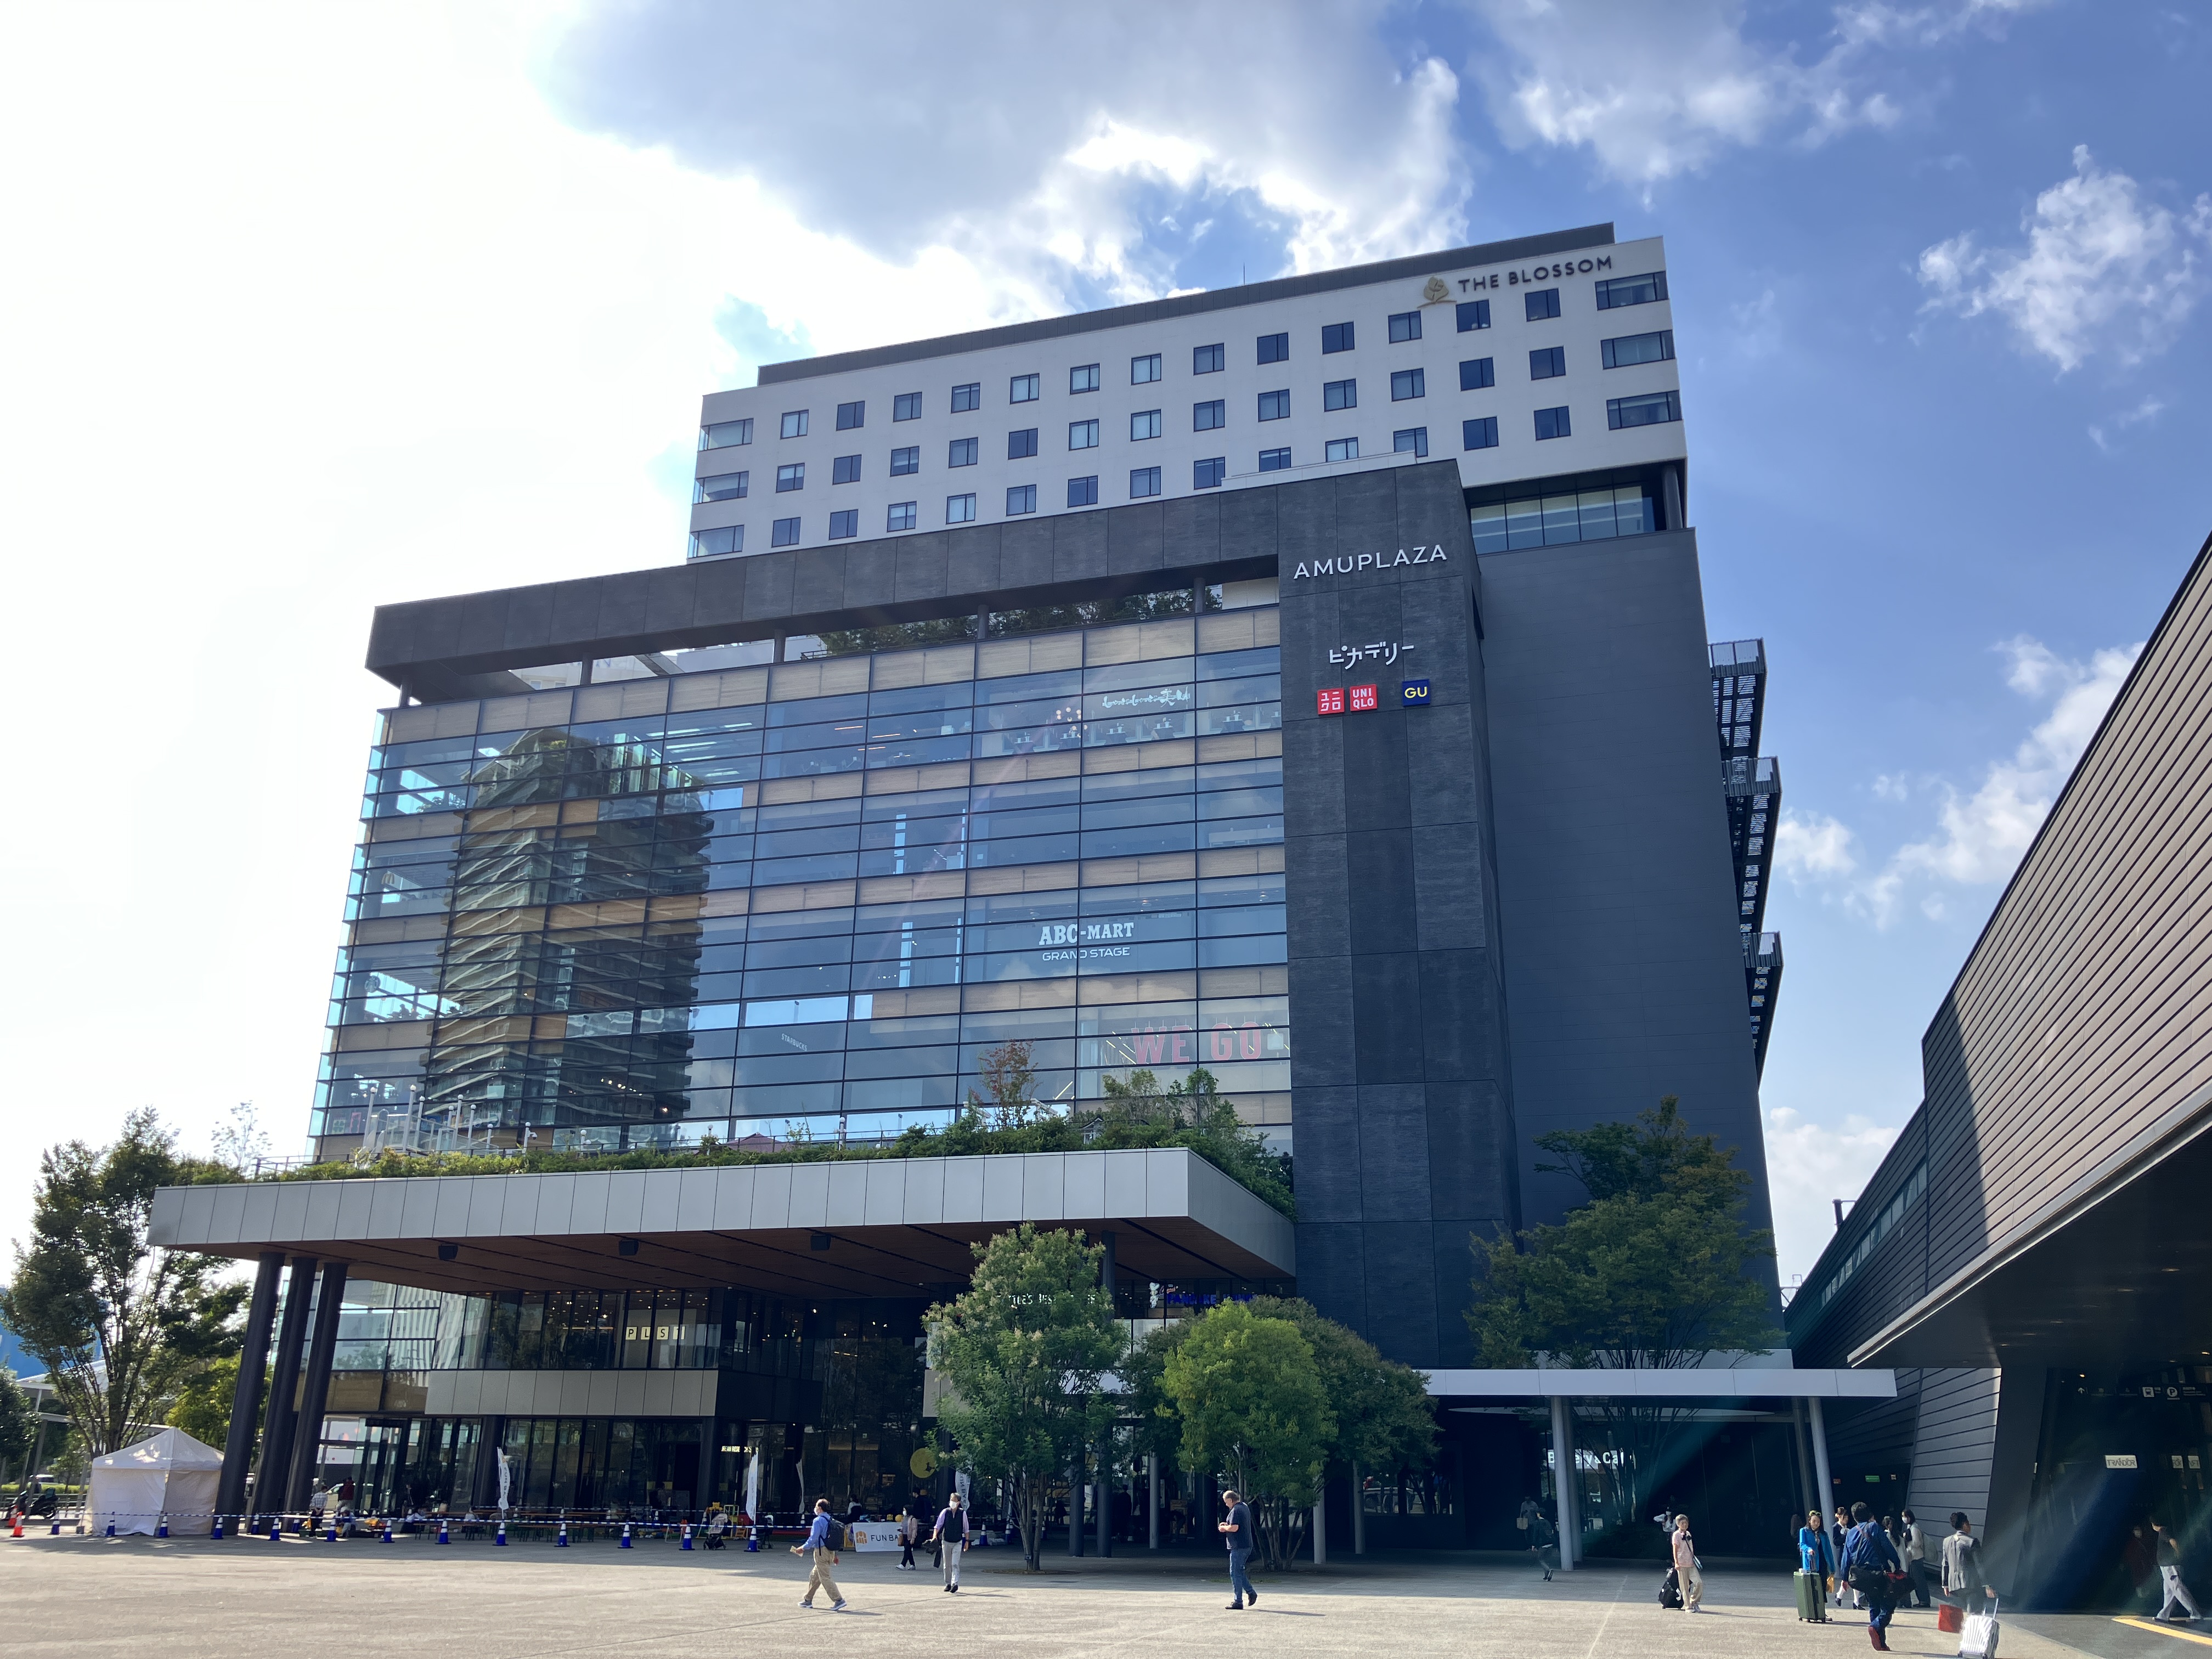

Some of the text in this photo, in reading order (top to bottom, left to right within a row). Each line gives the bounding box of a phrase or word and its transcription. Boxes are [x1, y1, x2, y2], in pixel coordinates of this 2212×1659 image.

[1458, 255, 1612, 293] THE BLOSSOM
[1293, 544, 1447, 579] AMUPLAZA
[1329, 641, 1414, 670] ピカデリー
[1352, 687, 1372, 698] UNI
[1404, 686, 1427, 698] GU
[1352, 698, 1374, 709] QLO
[1039, 922, 1135, 946] ABC-MART
[1042, 947, 1130, 961] GRAND STAGE
[781, 1033, 808, 1052] STARBUCKS
[628, 1328, 680, 1339] PLS
